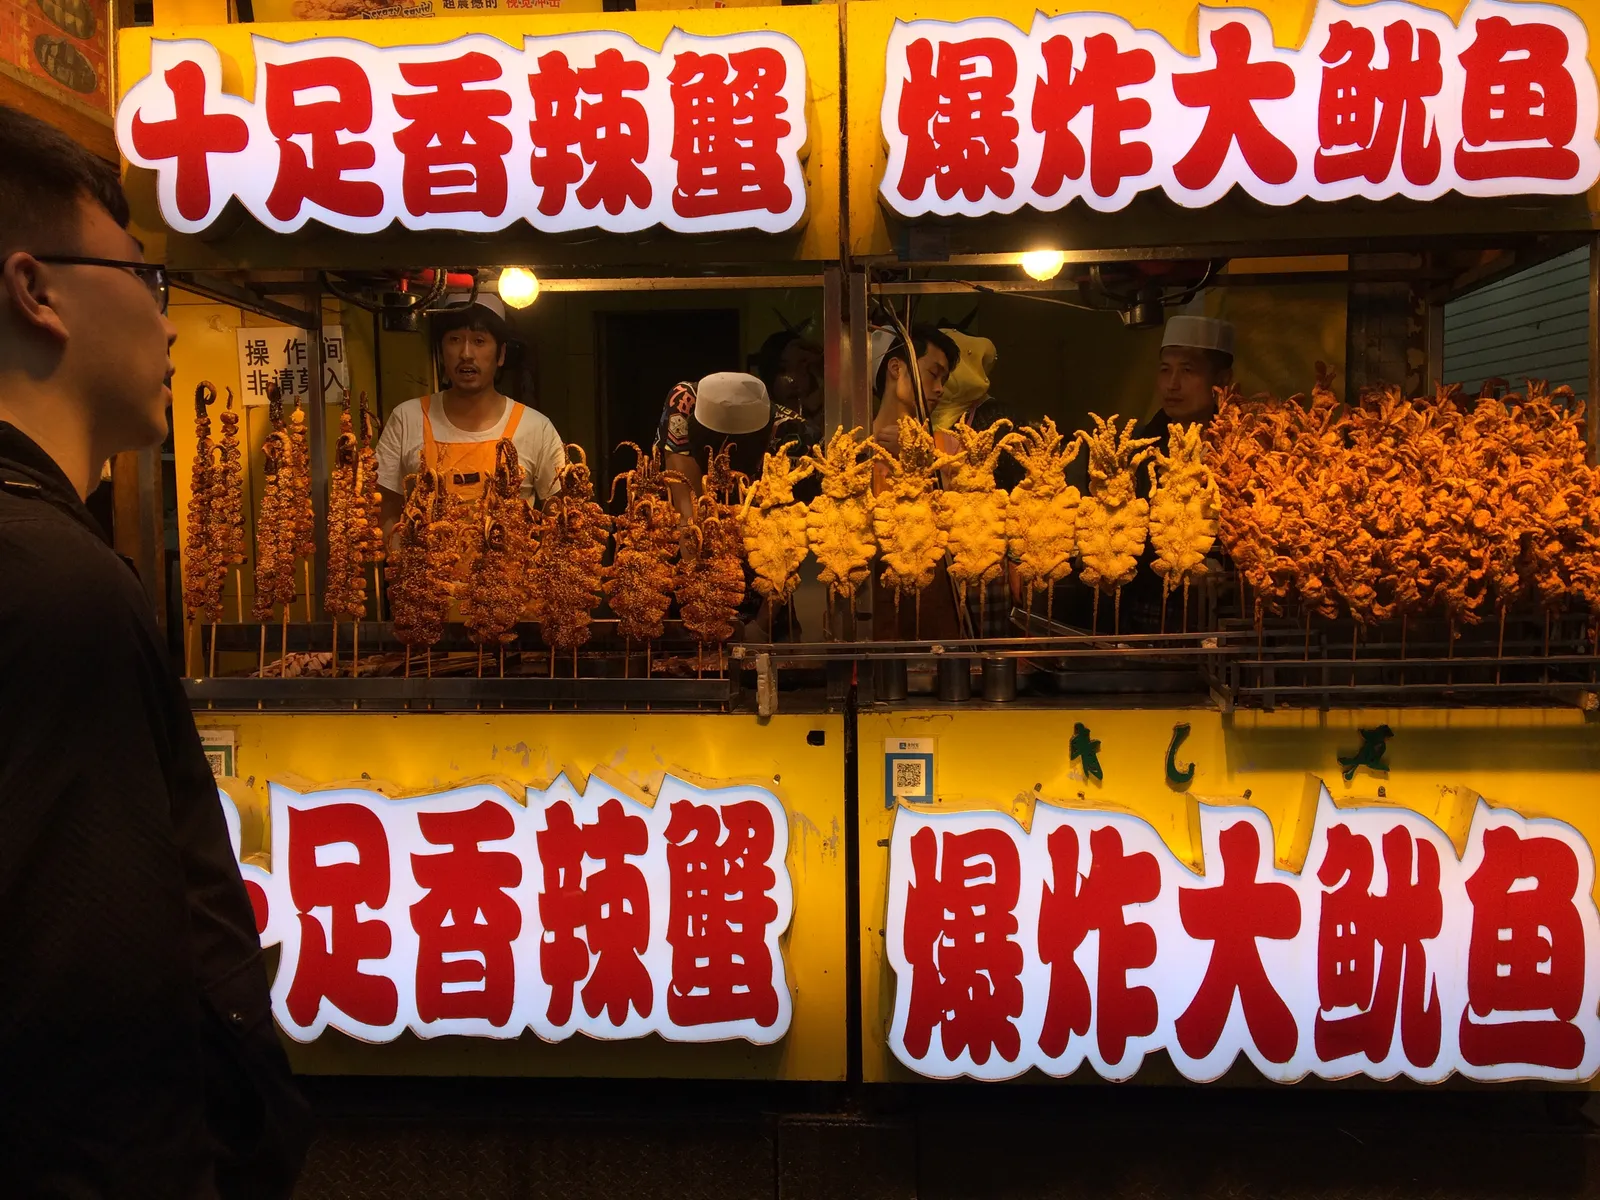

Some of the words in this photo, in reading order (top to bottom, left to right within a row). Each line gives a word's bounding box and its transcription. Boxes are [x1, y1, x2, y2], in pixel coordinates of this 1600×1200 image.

[132, 48, 792, 220] 十足香辣蟹
[898, 16, 1579, 202] 爆炸大鱿鱼
[245, 337, 343, 366] 操作间
[244, 799, 777, 1025] 足香辣蟹
[904, 821, 1585, 1063] 爆炸大鱿鱼
